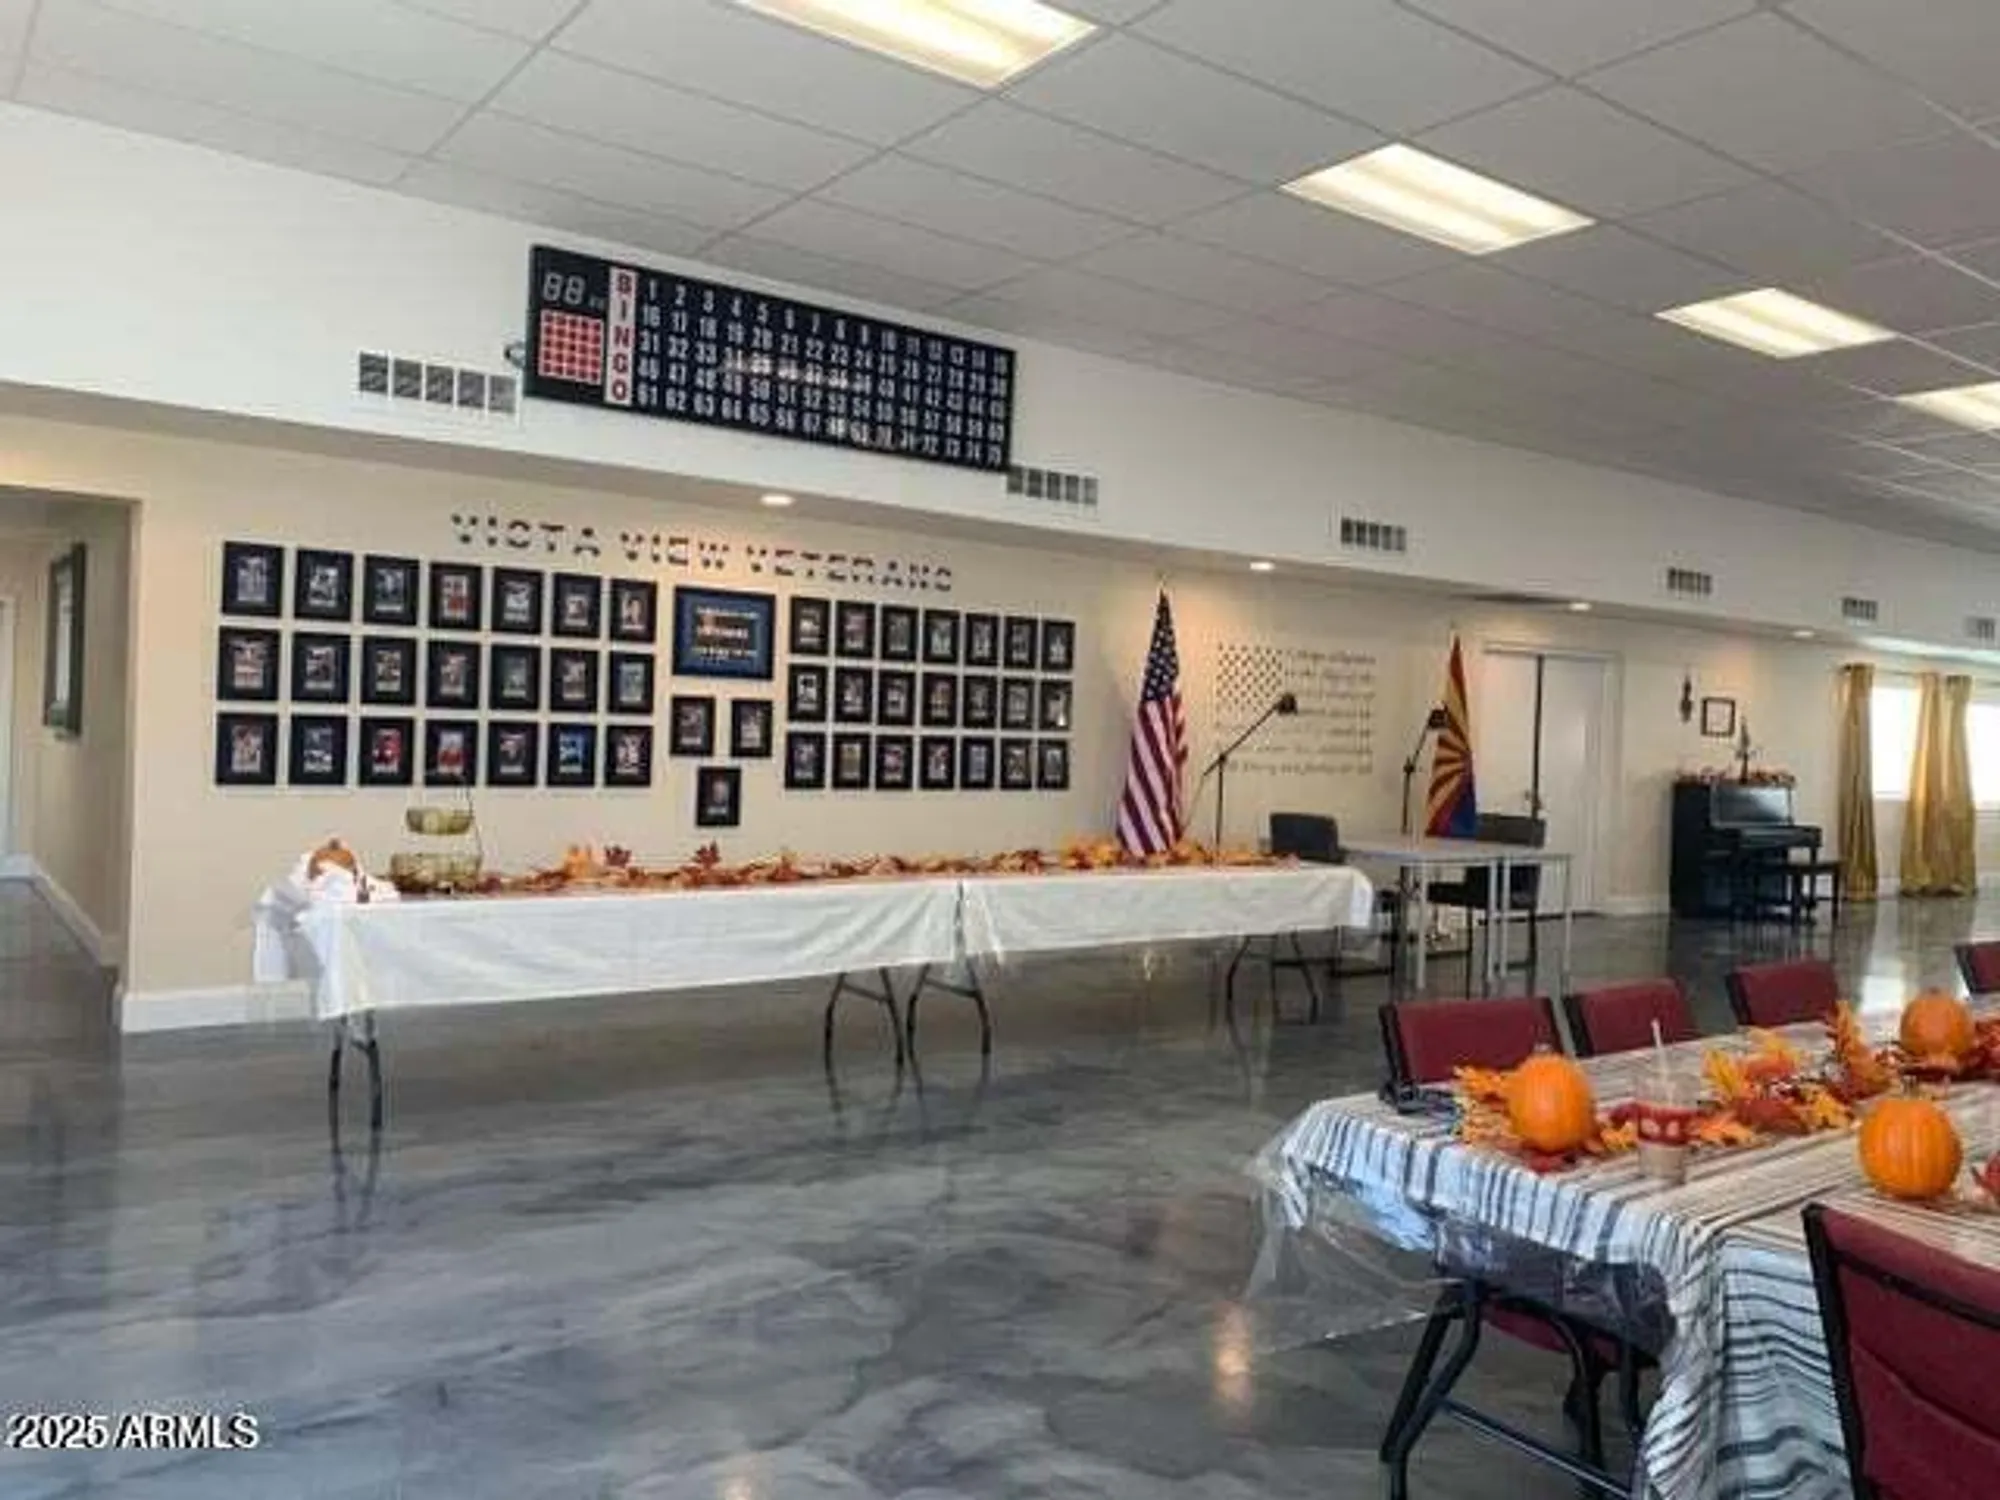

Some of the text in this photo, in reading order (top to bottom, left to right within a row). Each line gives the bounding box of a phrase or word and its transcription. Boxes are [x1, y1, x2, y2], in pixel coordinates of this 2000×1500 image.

[640, 330, 659, 354] 31
[669, 336, 688, 359] 32
[698, 342, 716, 365] 33
[641, 304, 660, 328] 16
[670, 310, 689, 333] 17
[699, 316, 717, 339] 18
[754, 327, 771, 350] 20
[780, 333, 797, 355] 21
[806, 338, 822, 360] 22
[639, 357, 658, 380] 46
[668, 362, 687, 385] 47
[638, 383, 657, 407] 61
[667, 388, 685, 412] 62
[695, 393, 714, 416] 63
[750, 403, 768, 425] 65
